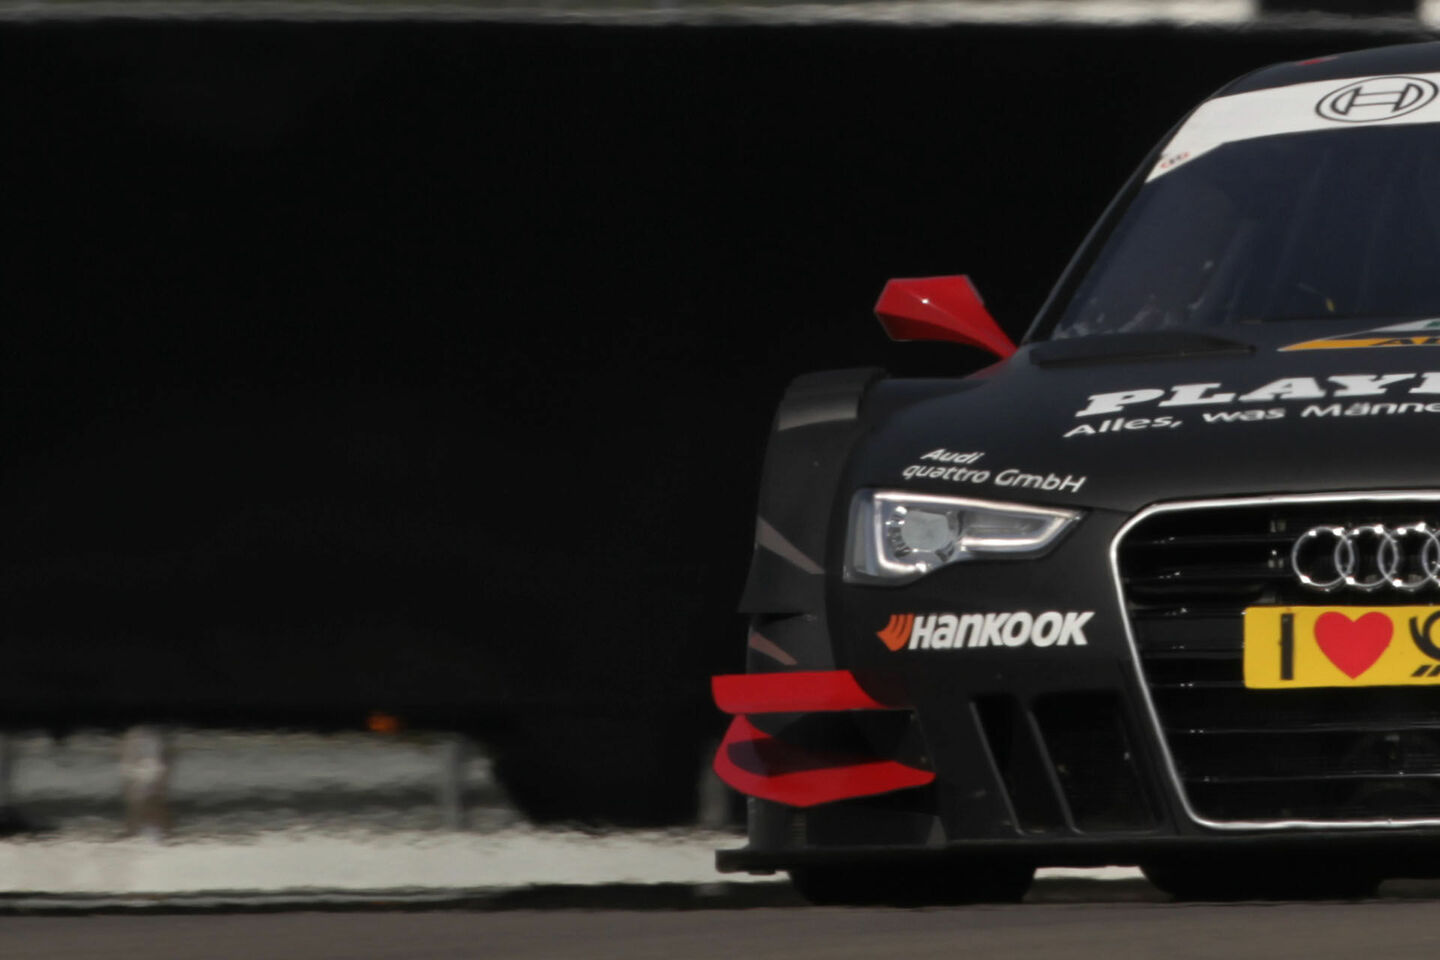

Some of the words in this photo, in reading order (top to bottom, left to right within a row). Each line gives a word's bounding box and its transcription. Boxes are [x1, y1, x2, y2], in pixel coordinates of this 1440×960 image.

[1063, 415, 1183, 438] Alles,
[1202, 407, 1287, 424] was
[920, 448, 985, 465] Audi
[902, 464, 991, 483] quattro
[994, 468, 1087, 493] GmbH
[1280, 612, 1295, 681] I
